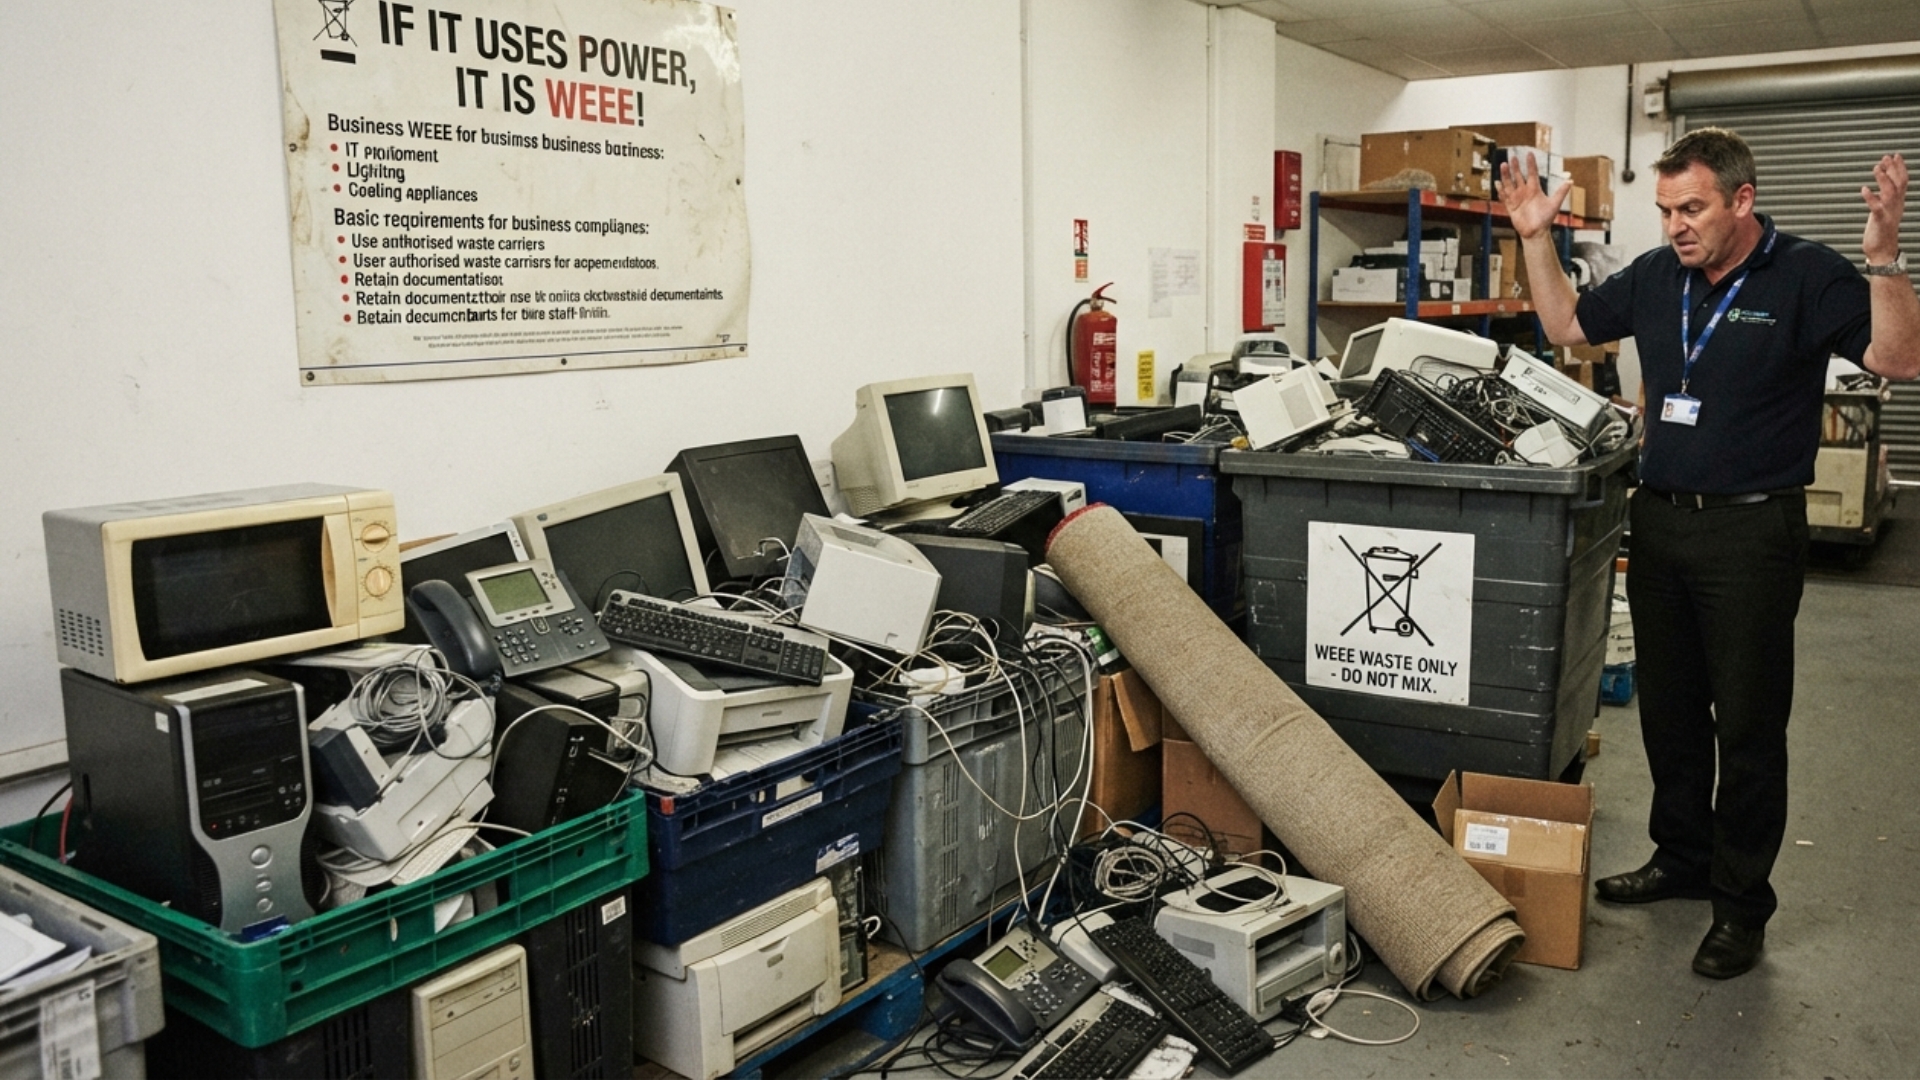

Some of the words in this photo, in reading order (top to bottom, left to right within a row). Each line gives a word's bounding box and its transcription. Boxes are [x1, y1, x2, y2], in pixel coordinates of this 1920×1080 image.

[379, 0, 414, 46] IF
[428, 9, 462, 53] IT
[475, 17, 568, 69] USES
[579, 35, 696, 95] POWER,
[456, 66, 489, 109] IT
[502, 73, 536, 115] IS
[545, 78, 644, 127] WEEE!
[328, 113, 404, 136] Business
[408, 120, 453, 141] WEEE
[456, 125, 477, 143] for
[542, 133, 601, 155] business
[345, 142, 359, 158] IT
[334, 208, 379, 227] Basic
[488, 214, 508, 230] for
[512, 215, 571, 232] business
[351, 233, 378, 249] Use
[457, 236, 495, 250] waste
[498, 236, 545, 251] carriers
[353, 253, 386, 268] User
[463, 255, 502, 269] waste
[354, 271, 399, 287] Retain
[356, 291, 401, 306] Retain
[1315, 643, 1356, 664] WEEE
[1360, 649, 1413, 671] WASTE
[1417, 657, 1458, 677] ONLY
[1341, 667, 1362, 684] DO
[1367, 670, 1398, 689] NOT
[1402, 676, 1437, 694] MIX.
